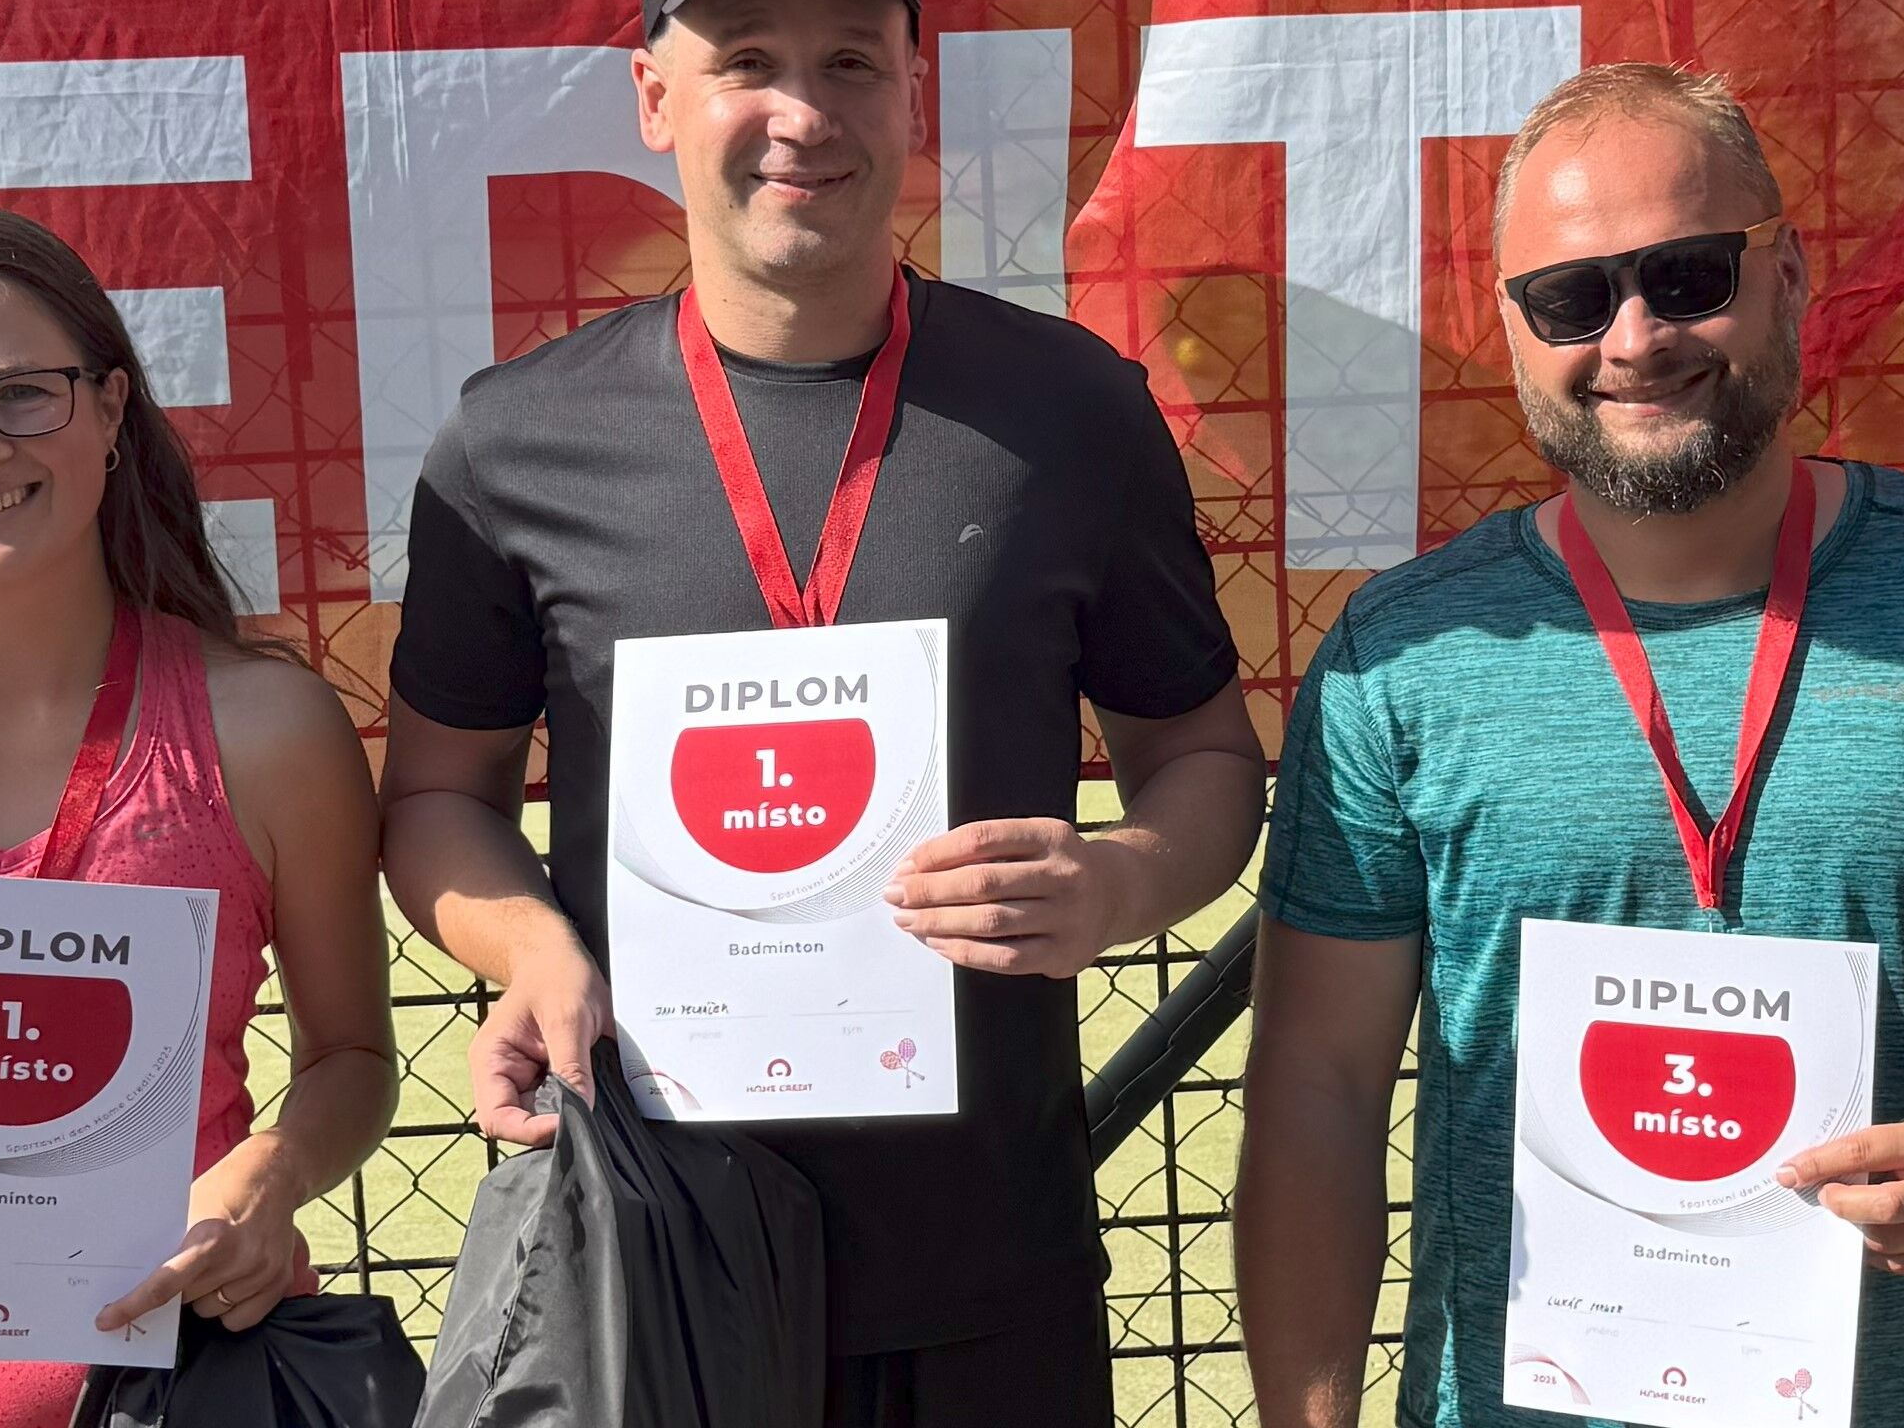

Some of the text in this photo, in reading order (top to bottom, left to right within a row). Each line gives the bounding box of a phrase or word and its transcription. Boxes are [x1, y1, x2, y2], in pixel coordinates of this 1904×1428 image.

[685, 674, 869, 713] DIPLOM
[754, 749, 793, 788] 1.
[722, 801, 827, 829] místo
[728, 941, 825, 957] Badminton
[1594, 975, 1791, 1022] DIPLOM
[2, 1001, 41, 1041] 1.
[1663, 1054, 1713, 1097] 3.
[1633, 1108, 1742, 1141] místo
[1633, 1244, 1731, 1268] Badminton
